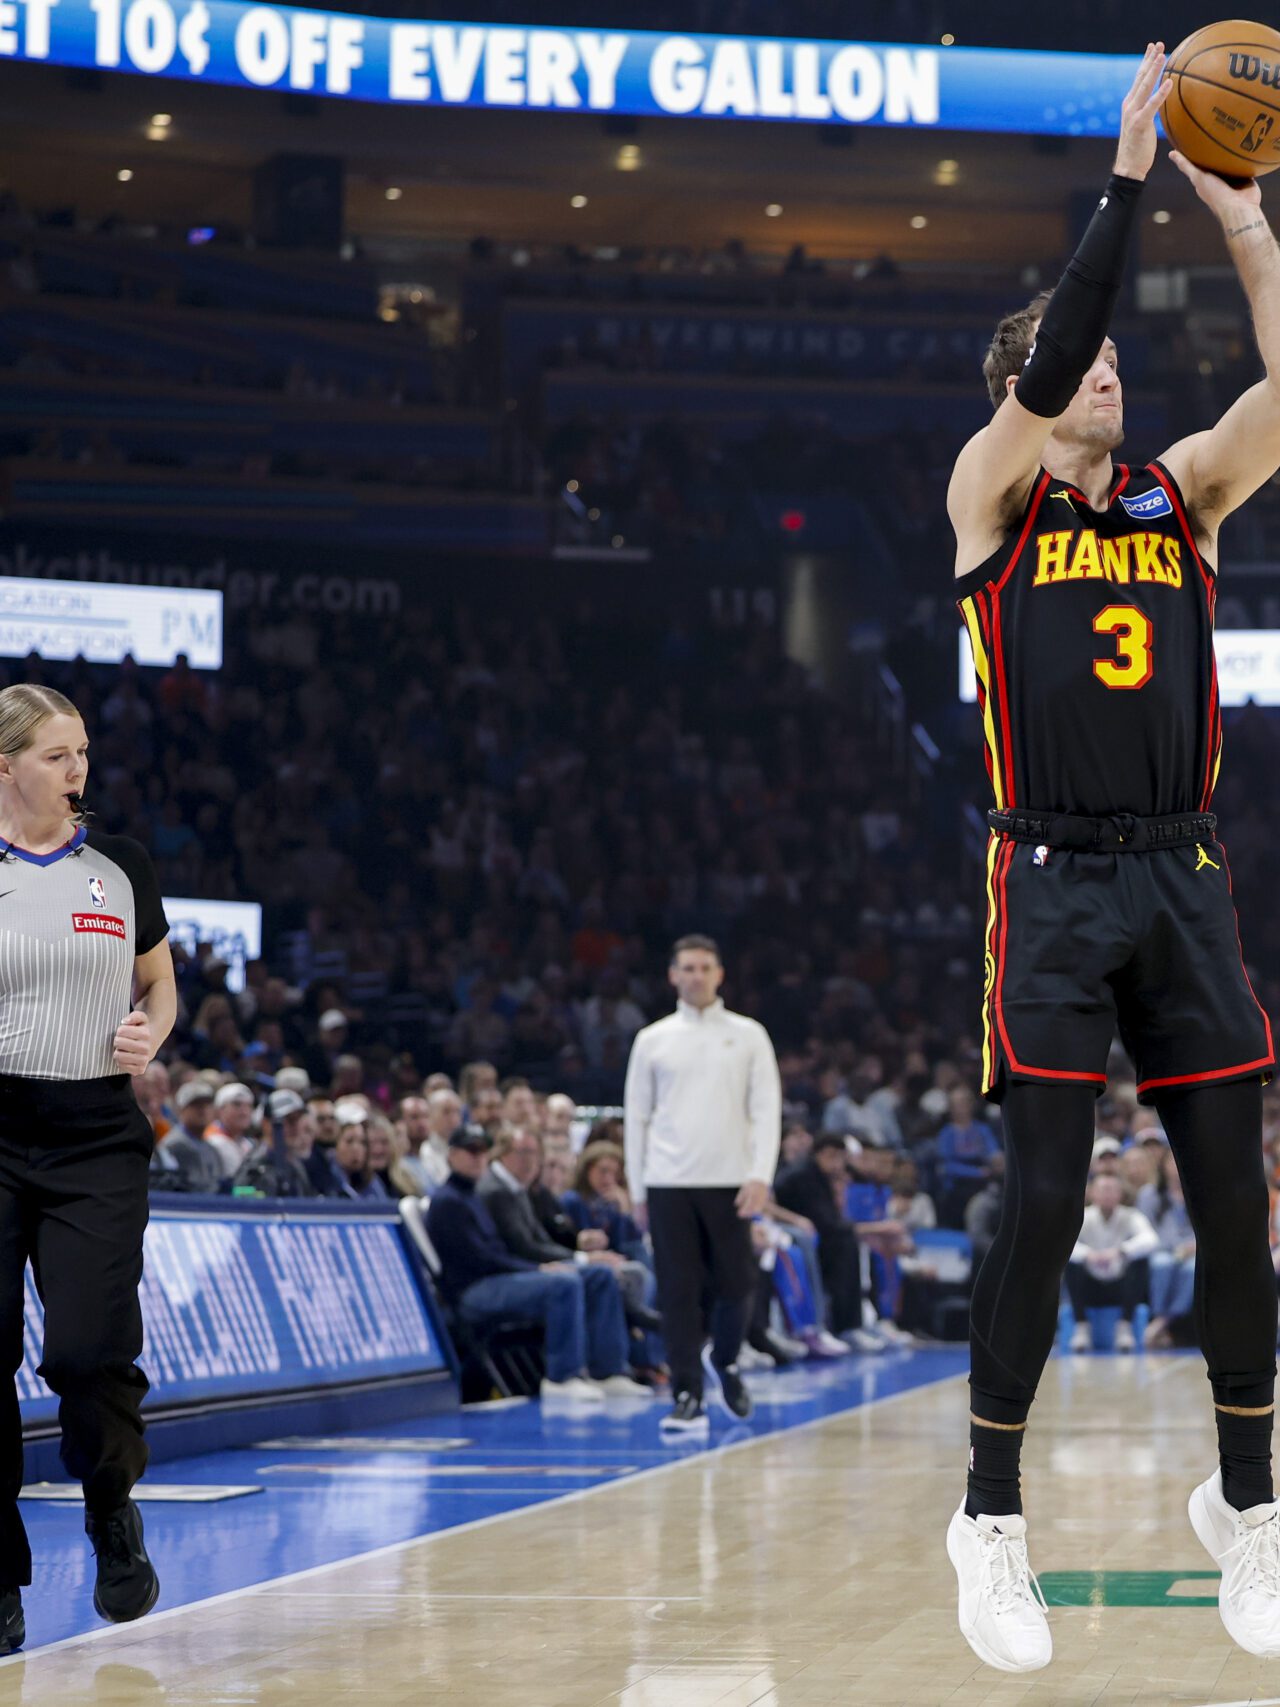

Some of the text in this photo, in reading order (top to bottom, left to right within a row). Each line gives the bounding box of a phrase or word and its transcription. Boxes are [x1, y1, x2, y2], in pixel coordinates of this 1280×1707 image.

[90, 0, 211, 75] 10¢
[235, 6, 364, 94] OFF
[389, 23, 629, 110] EVERY
[649, 35, 940, 124] GALLON
[1093, 605, 1153, 689] 3
[74, 916, 125, 935] Emirates
